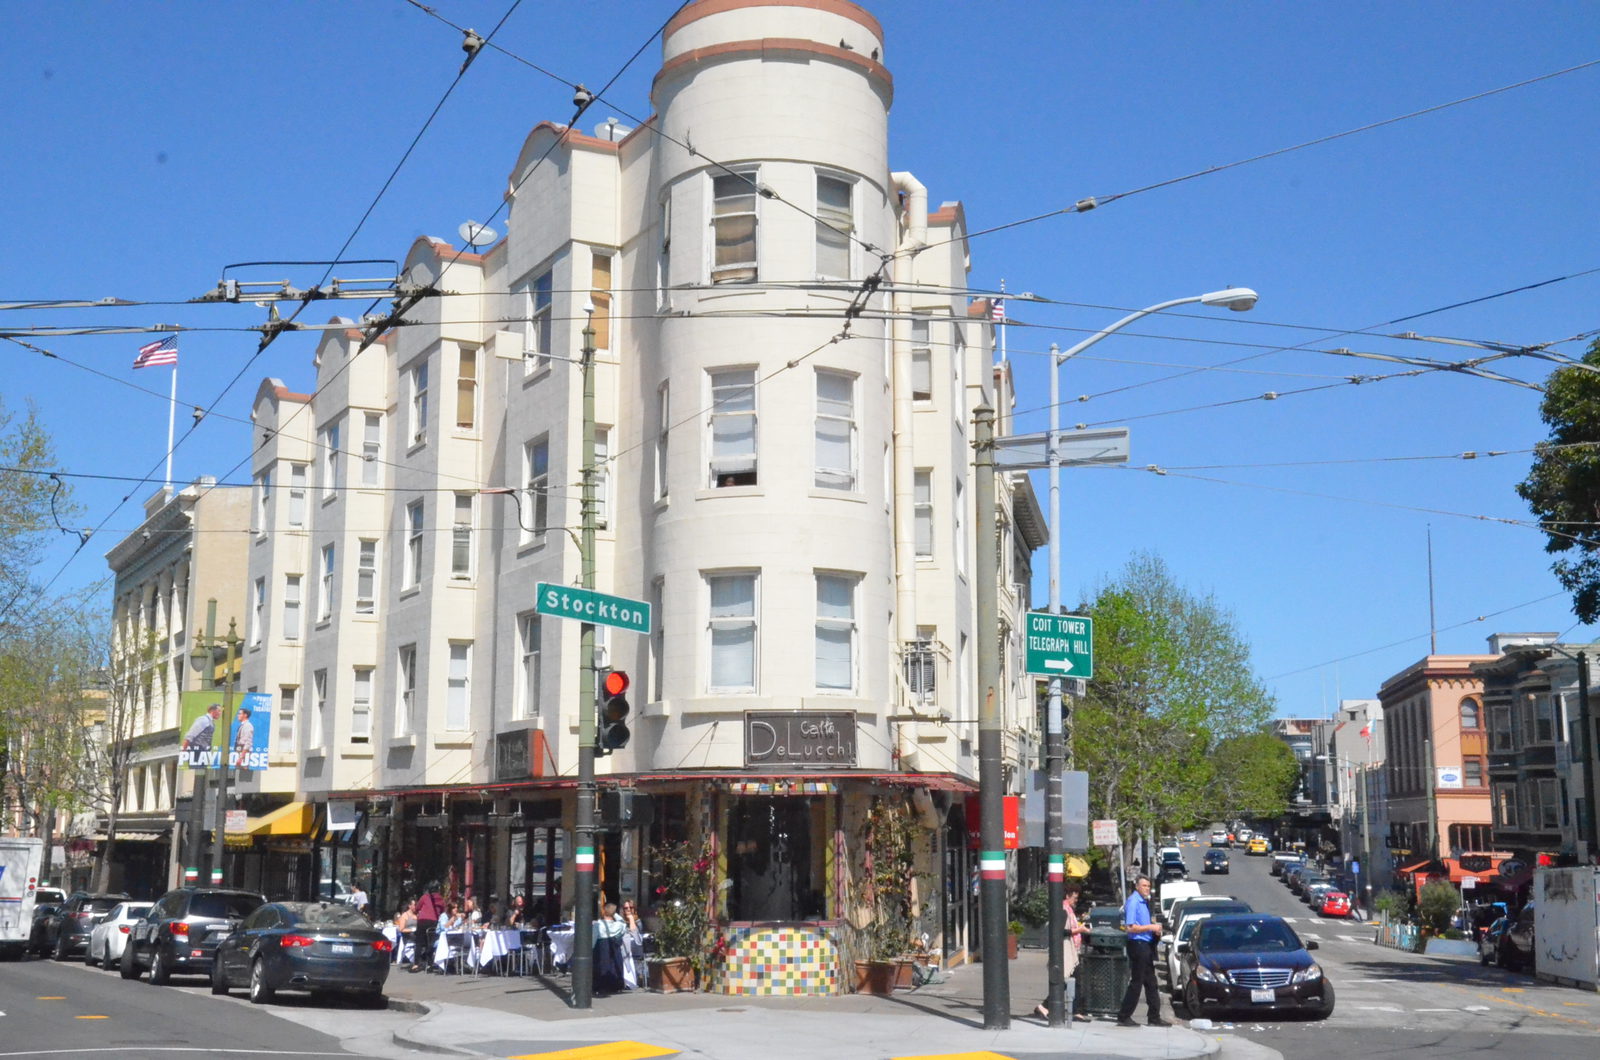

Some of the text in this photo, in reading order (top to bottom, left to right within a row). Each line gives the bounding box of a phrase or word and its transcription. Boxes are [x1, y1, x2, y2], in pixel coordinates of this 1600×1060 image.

[546, 590, 643, 625] Stockton
[1032, 617, 1086, 636] COIT TOWER
[1028, 635, 1089, 655] TELEGRAPH HILL
